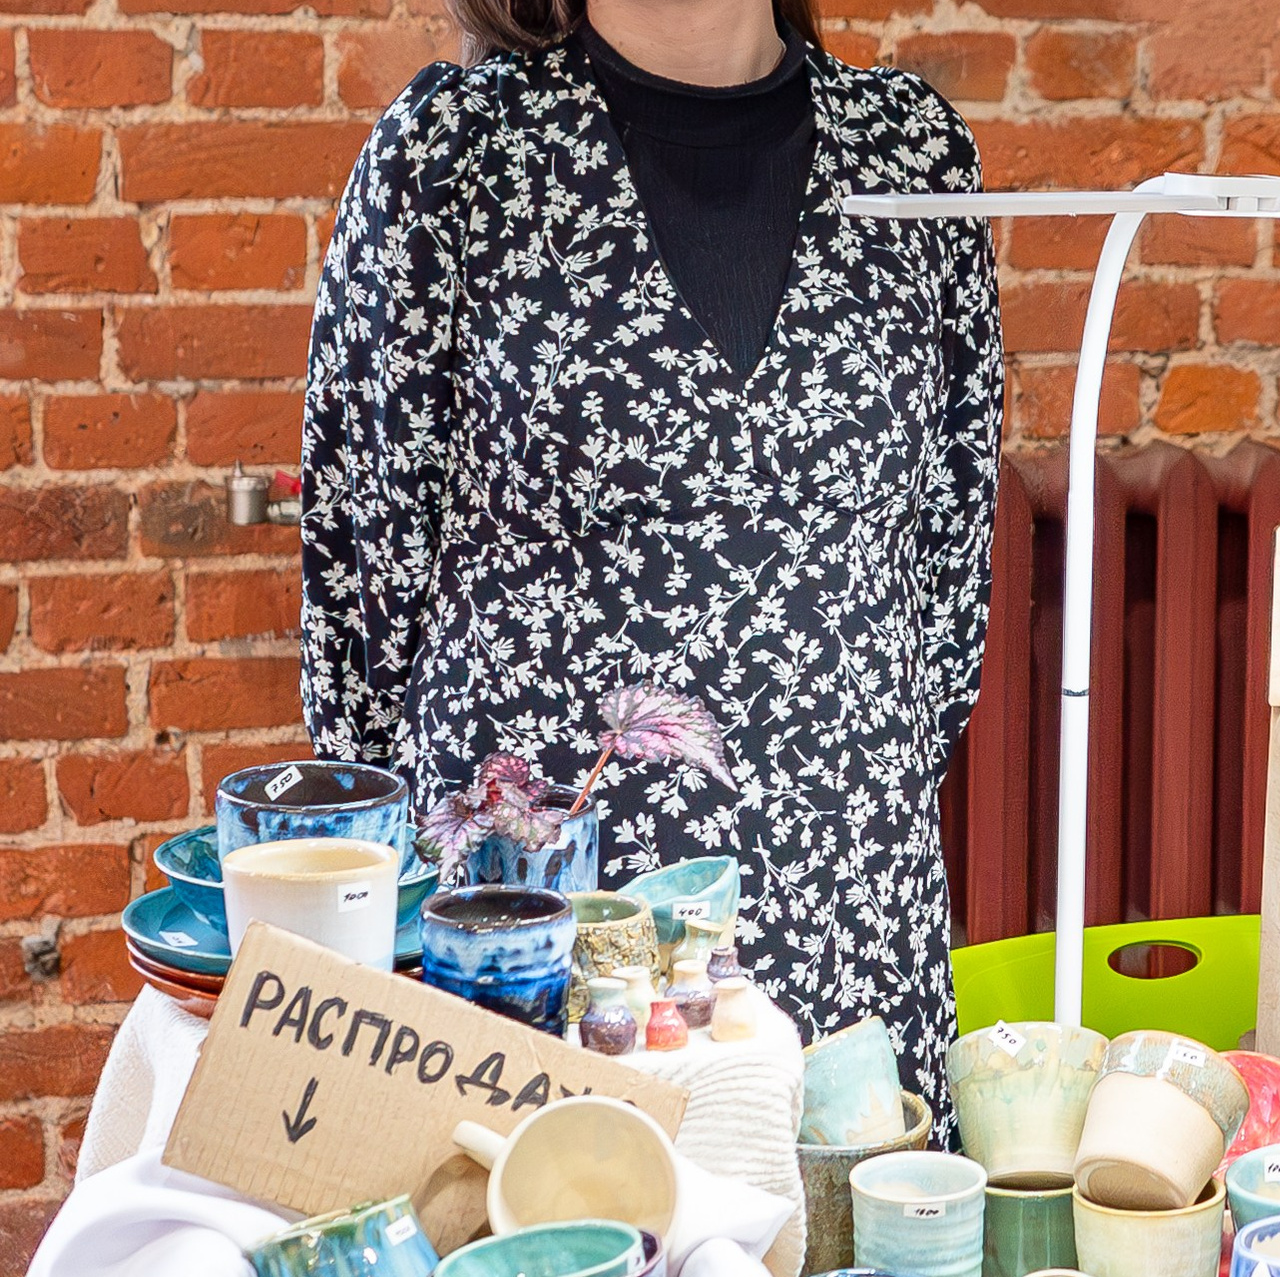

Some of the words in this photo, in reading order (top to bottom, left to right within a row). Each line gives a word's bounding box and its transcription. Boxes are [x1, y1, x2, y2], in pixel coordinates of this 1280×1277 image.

[272, 773, 293, 794] 750
[678, 908, 703, 918] 400
[240, 970, 636, 1113] РАСПРОДА
[997, 1026, 1017, 1045] 750
